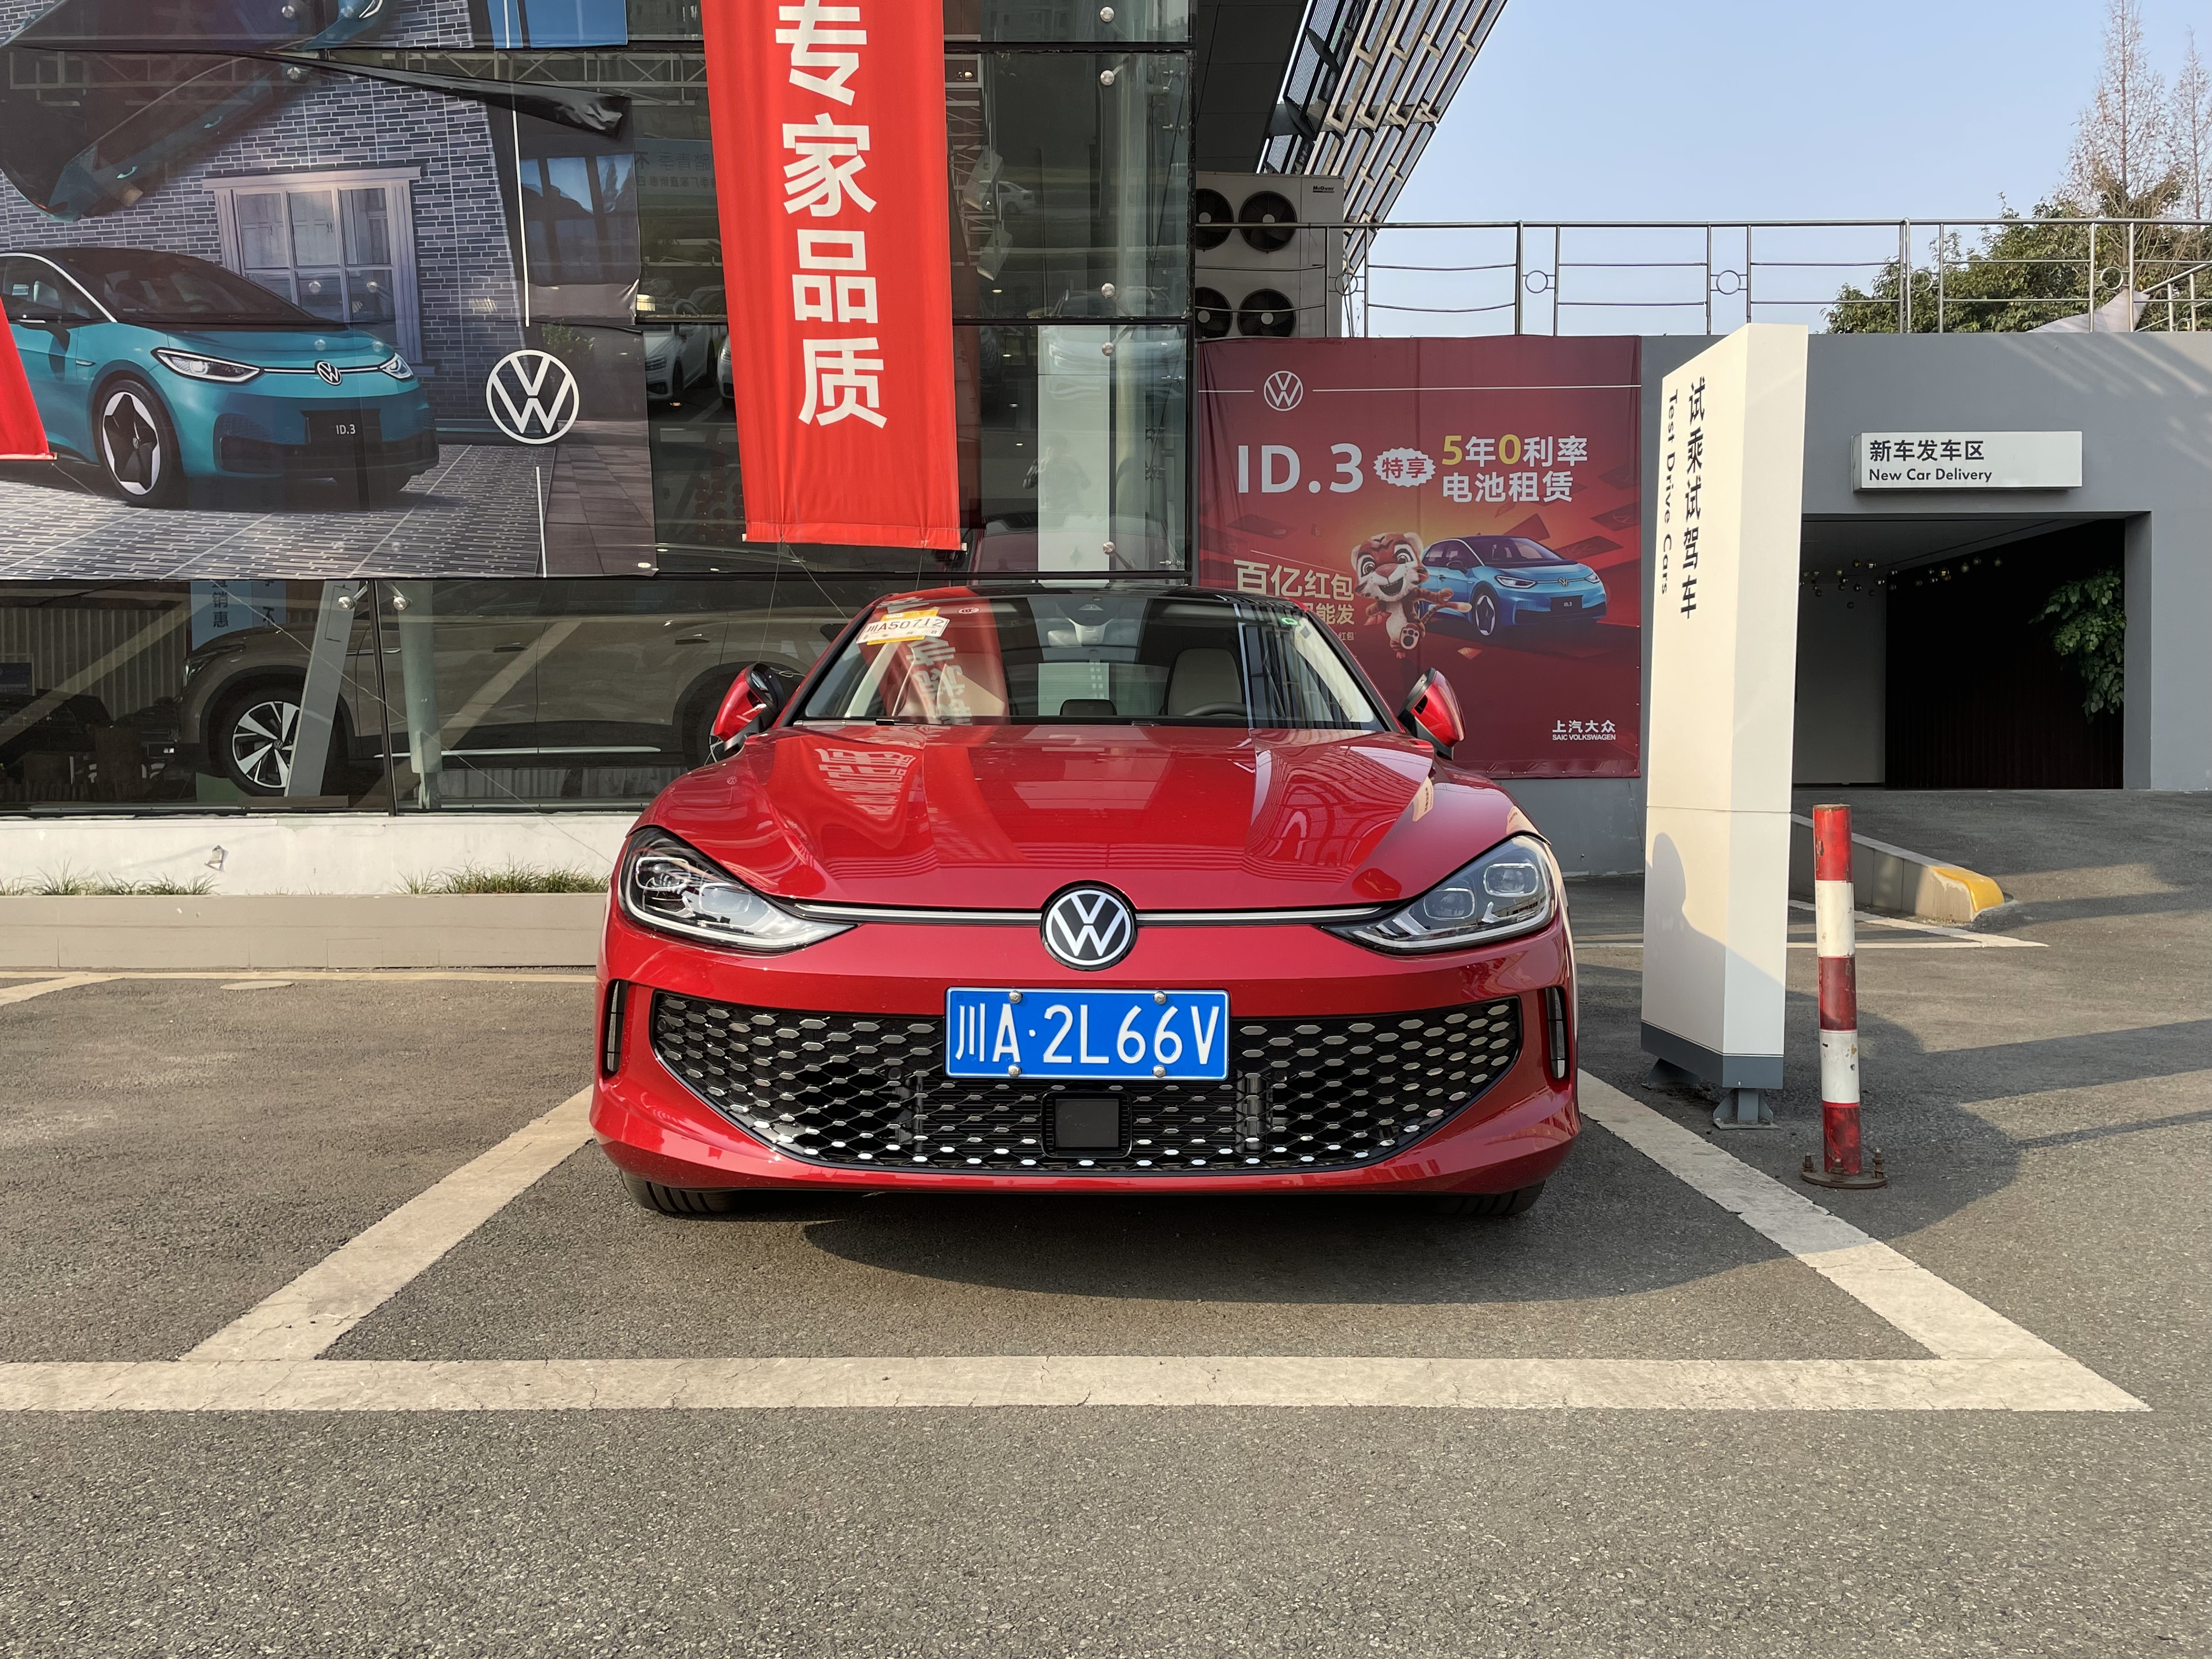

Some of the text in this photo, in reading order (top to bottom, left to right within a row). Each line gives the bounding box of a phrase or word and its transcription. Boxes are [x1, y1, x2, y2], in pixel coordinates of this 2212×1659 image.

[775, 0, 888, 429] 专家品质
[336, 424, 356, 435] ID.3
[1442, 434, 1588, 467] 5年0利率
[1870, 439, 1984, 462] 新车发车区
[1238, 443, 1364, 494] ID.3
[1381, 456, 1427, 479] 特享
[1869, 468, 1992, 482] New Car Delivery
[1443, 470, 1573, 503] 电池租赁
[1661, 388, 1678, 595] Test Drive Cars
[1681, 376, 1706, 619] 试乘试驾车
[1234, 559, 1355, 601] 百亿红包
[1302, 602, 1355, 625] 能发
[1552, 719, 1616, 733] 上汽大众
